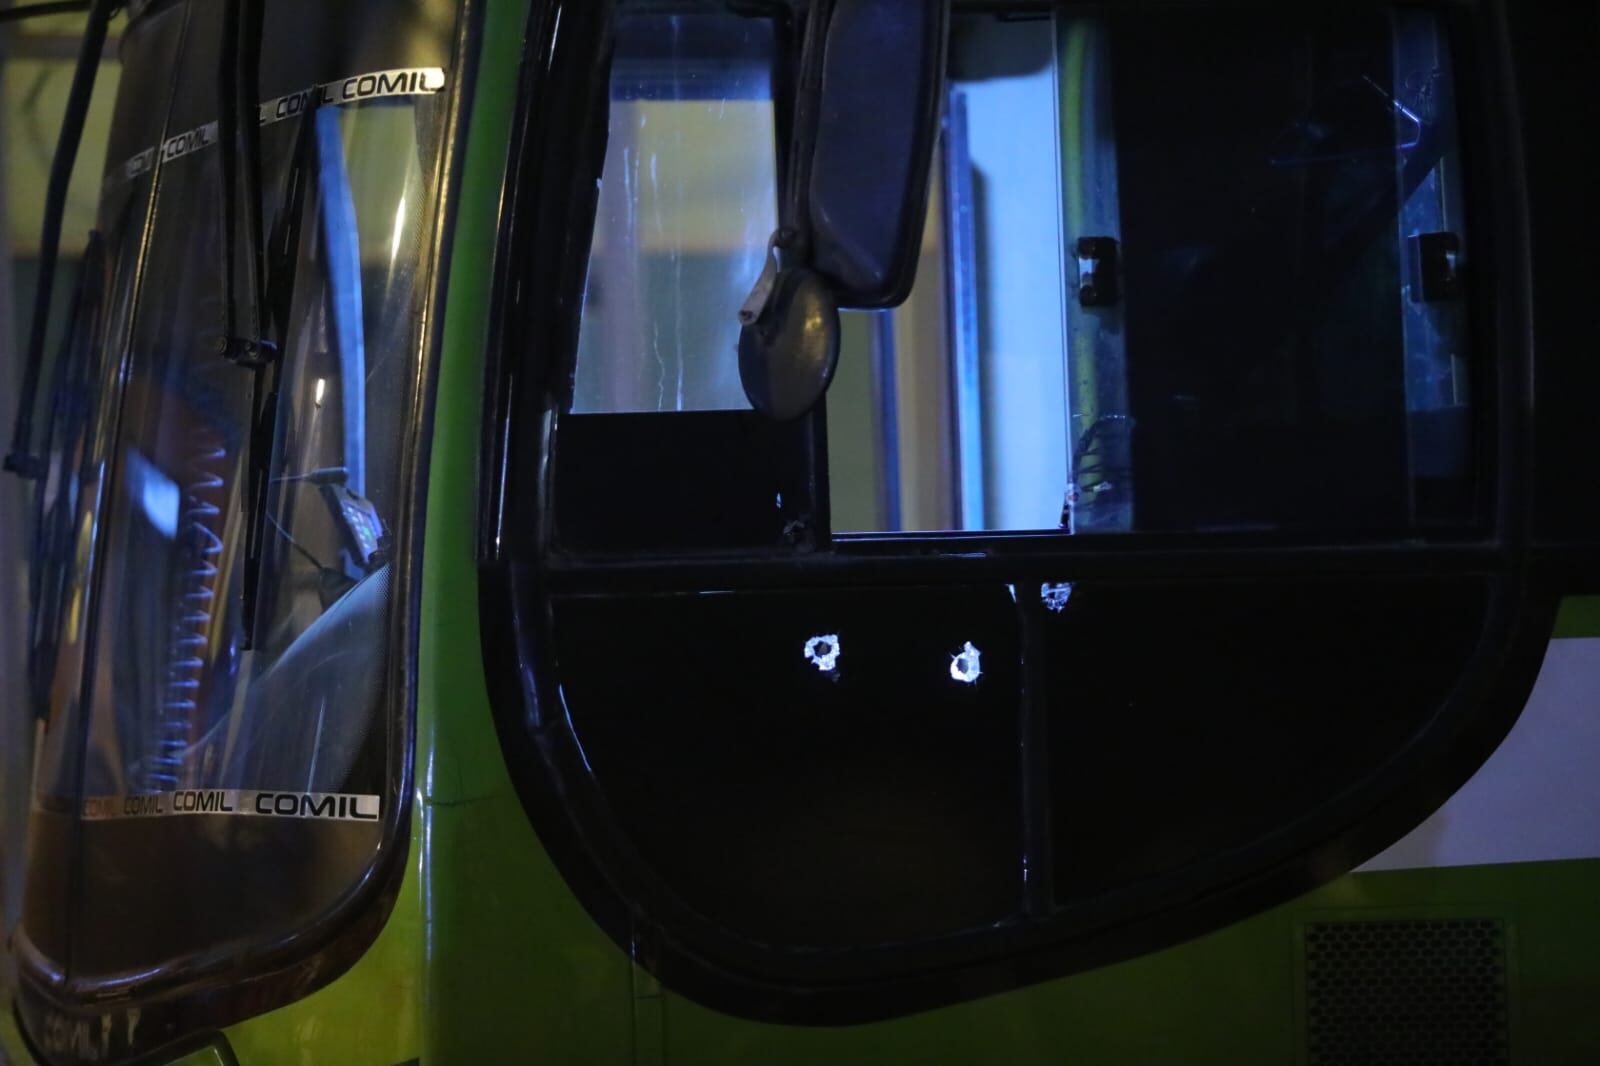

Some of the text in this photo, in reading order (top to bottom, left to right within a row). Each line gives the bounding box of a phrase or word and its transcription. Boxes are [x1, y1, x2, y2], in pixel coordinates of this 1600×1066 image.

[342, 72, 445, 100] COMIL
[173, 791, 233, 812] COMIL
[256, 793, 377, 819] COMIL
